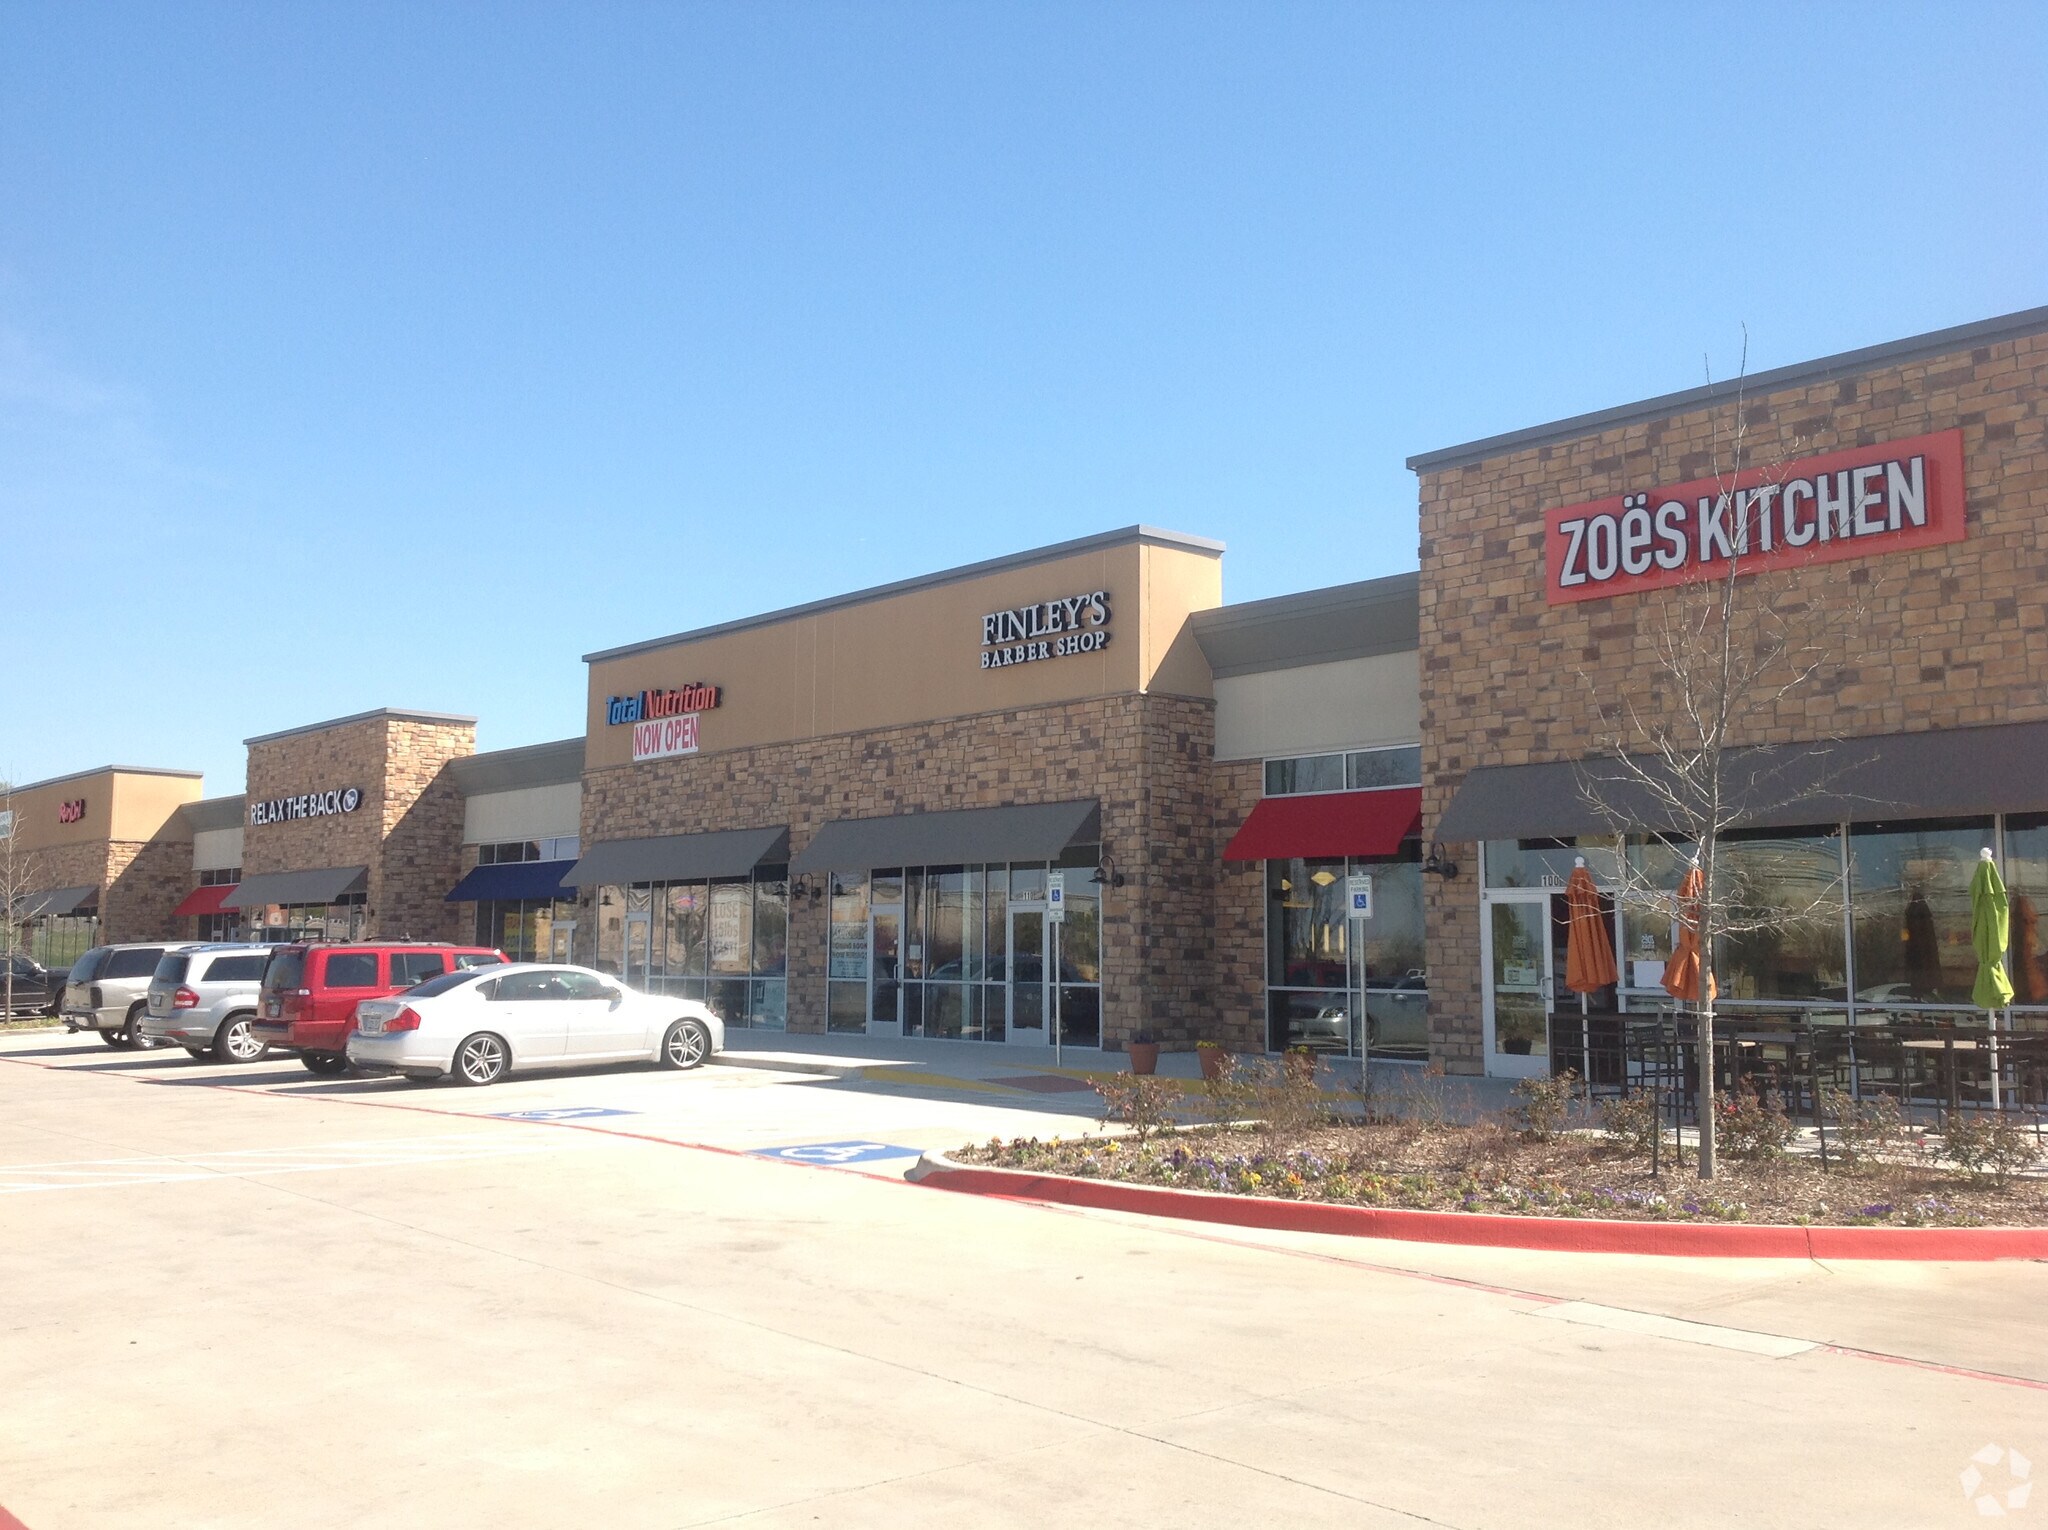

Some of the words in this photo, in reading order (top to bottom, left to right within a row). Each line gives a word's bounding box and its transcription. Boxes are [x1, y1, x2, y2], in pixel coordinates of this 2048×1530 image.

[1698, 455, 1927, 563] KITCHEN
[981, 590, 1107, 646] FINLEY'S
[981, 641, 1051, 669] BARBER
[1056, 630, 1106, 656] SHOP
[606, 690, 645, 726] Total
[644, 682, 719, 719] Nutrition
[634, 722, 662, 757] NOW
[665, 715, 699, 752] OPEN
[251, 799, 284, 826] RELAX
[286, 795, 308, 820] THE
[309, 789, 342, 817] BACK
[1541, 875, 1560, 887] 100
